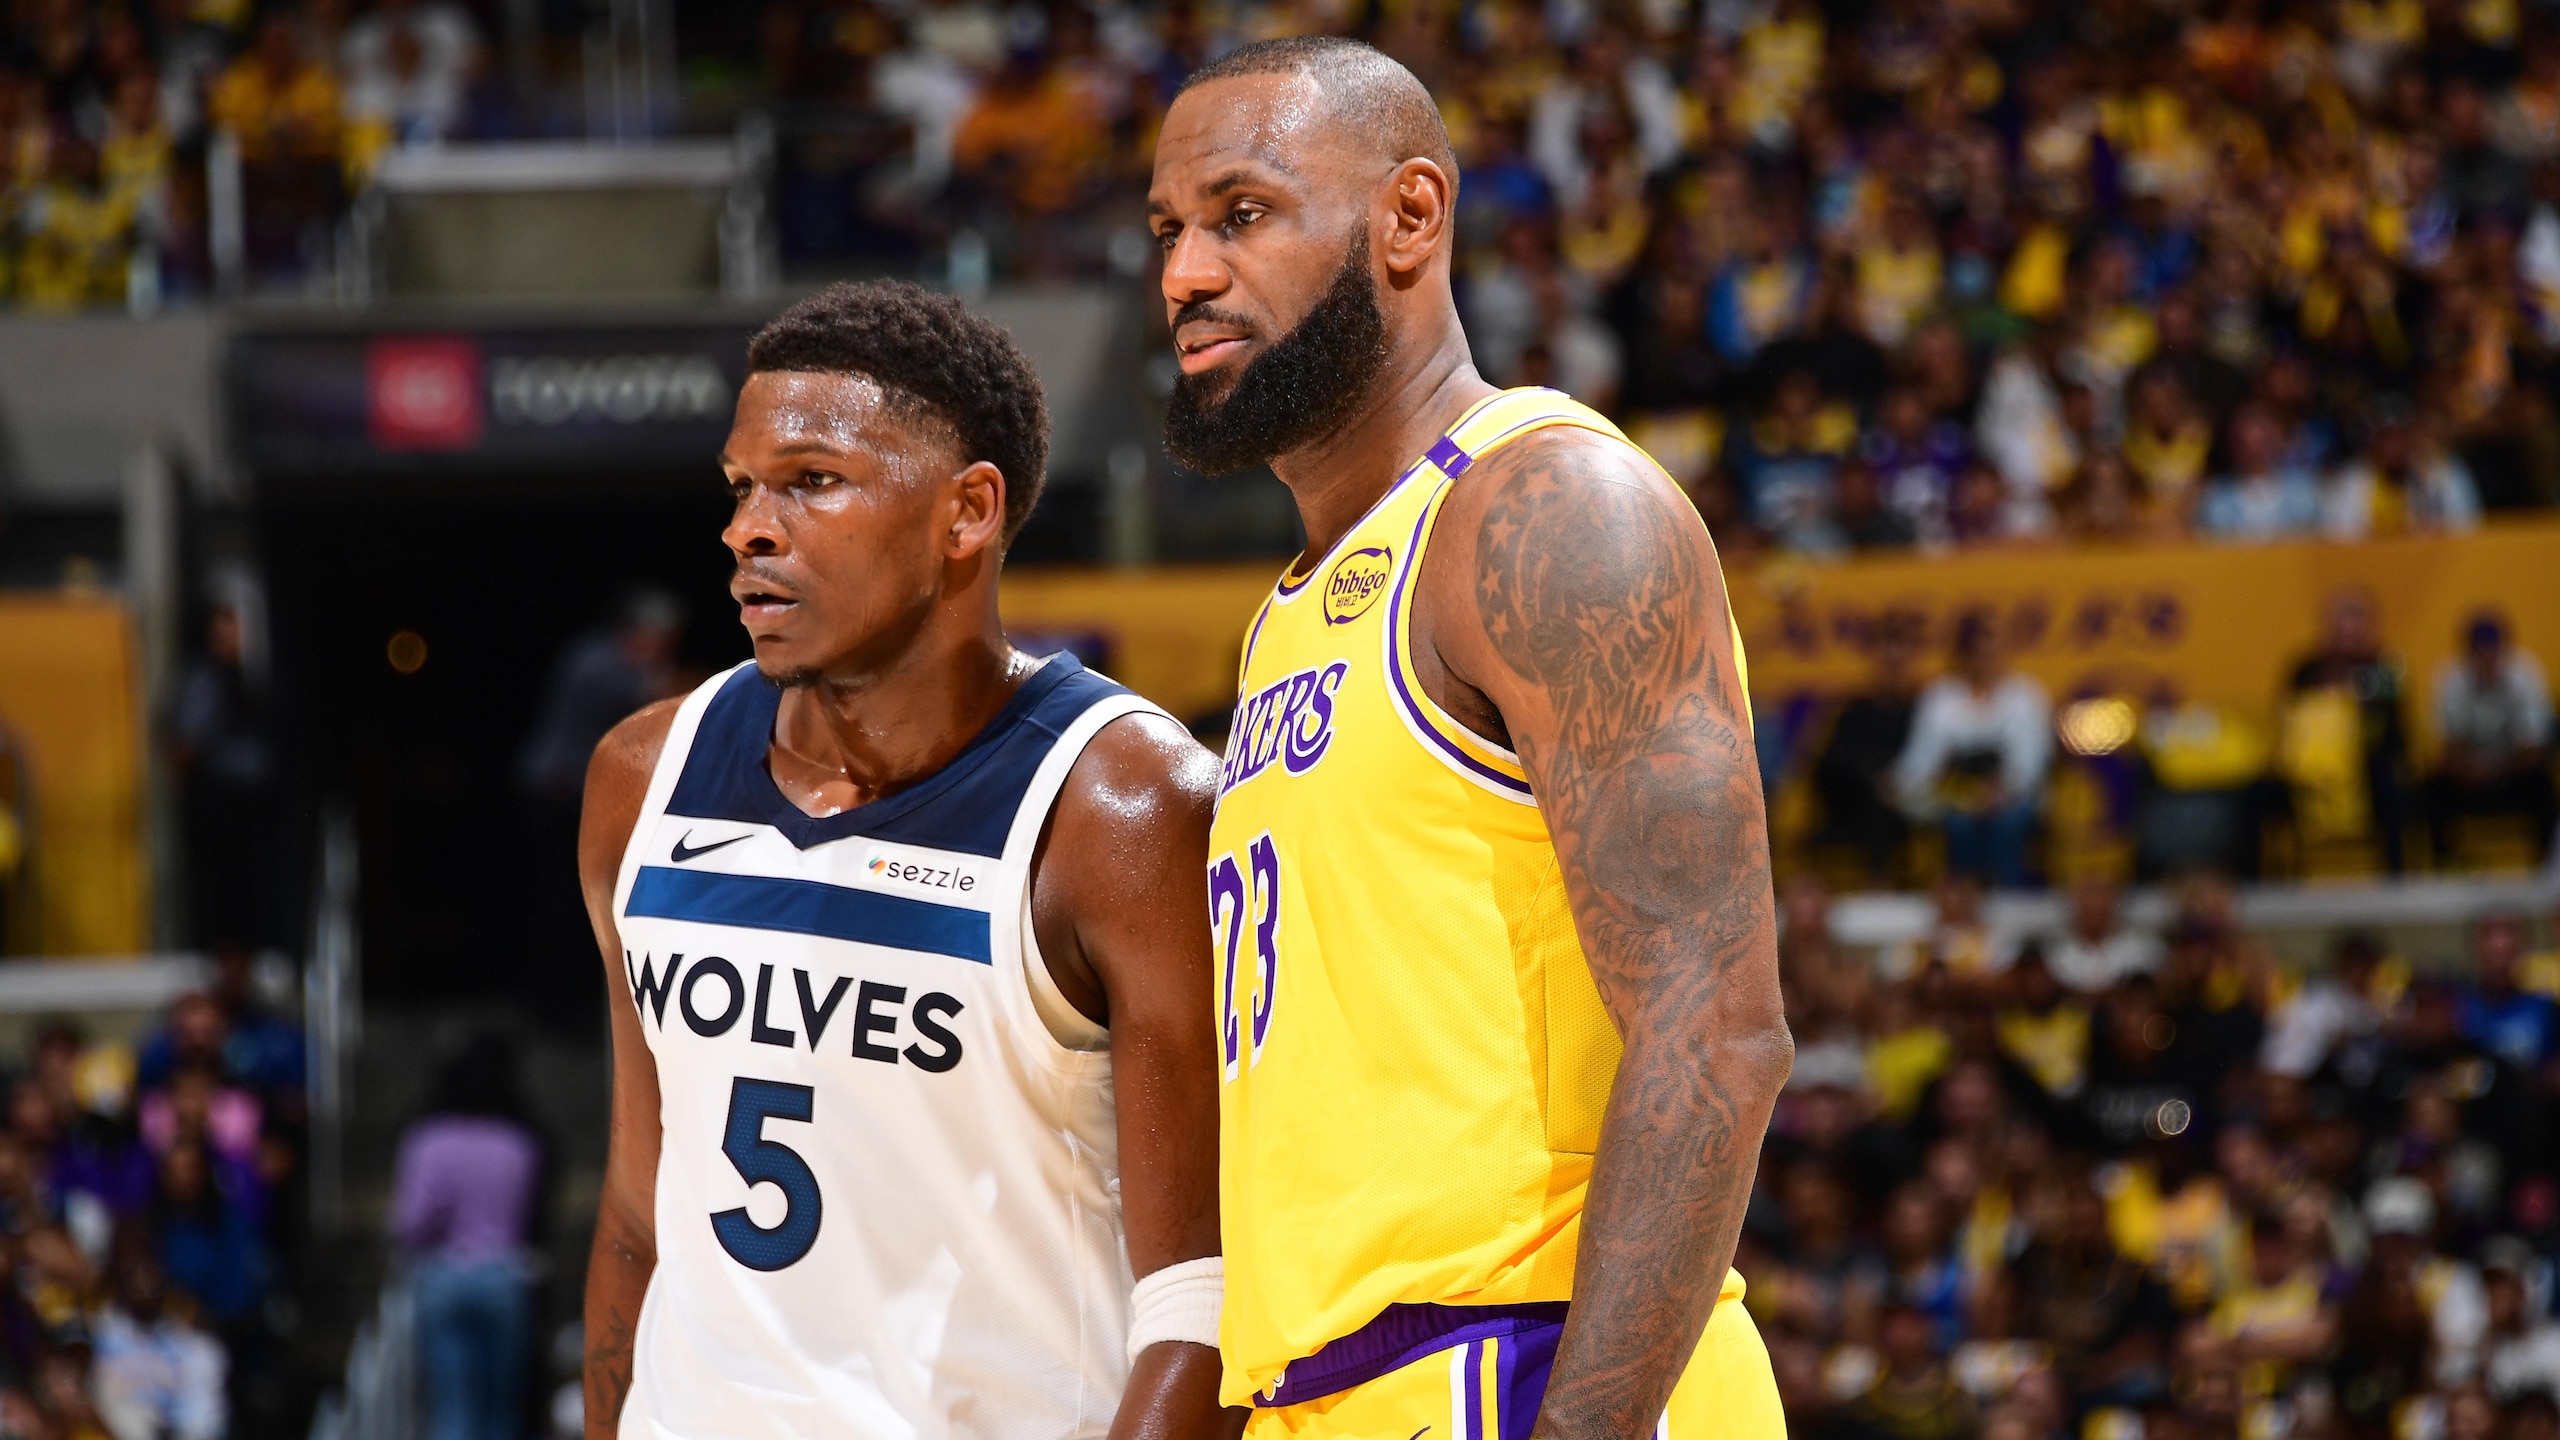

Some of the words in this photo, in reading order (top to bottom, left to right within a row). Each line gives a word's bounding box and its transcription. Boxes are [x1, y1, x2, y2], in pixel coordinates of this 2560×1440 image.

[1331, 567, 1387, 600] bibigo
[1215, 659, 1352, 802] AKERS
[887, 861, 976, 892] sezzle
[626, 949, 965, 1074] WOLVES
[1207, 828, 1281, 1085] 23
[709, 1075, 823, 1273] 5
